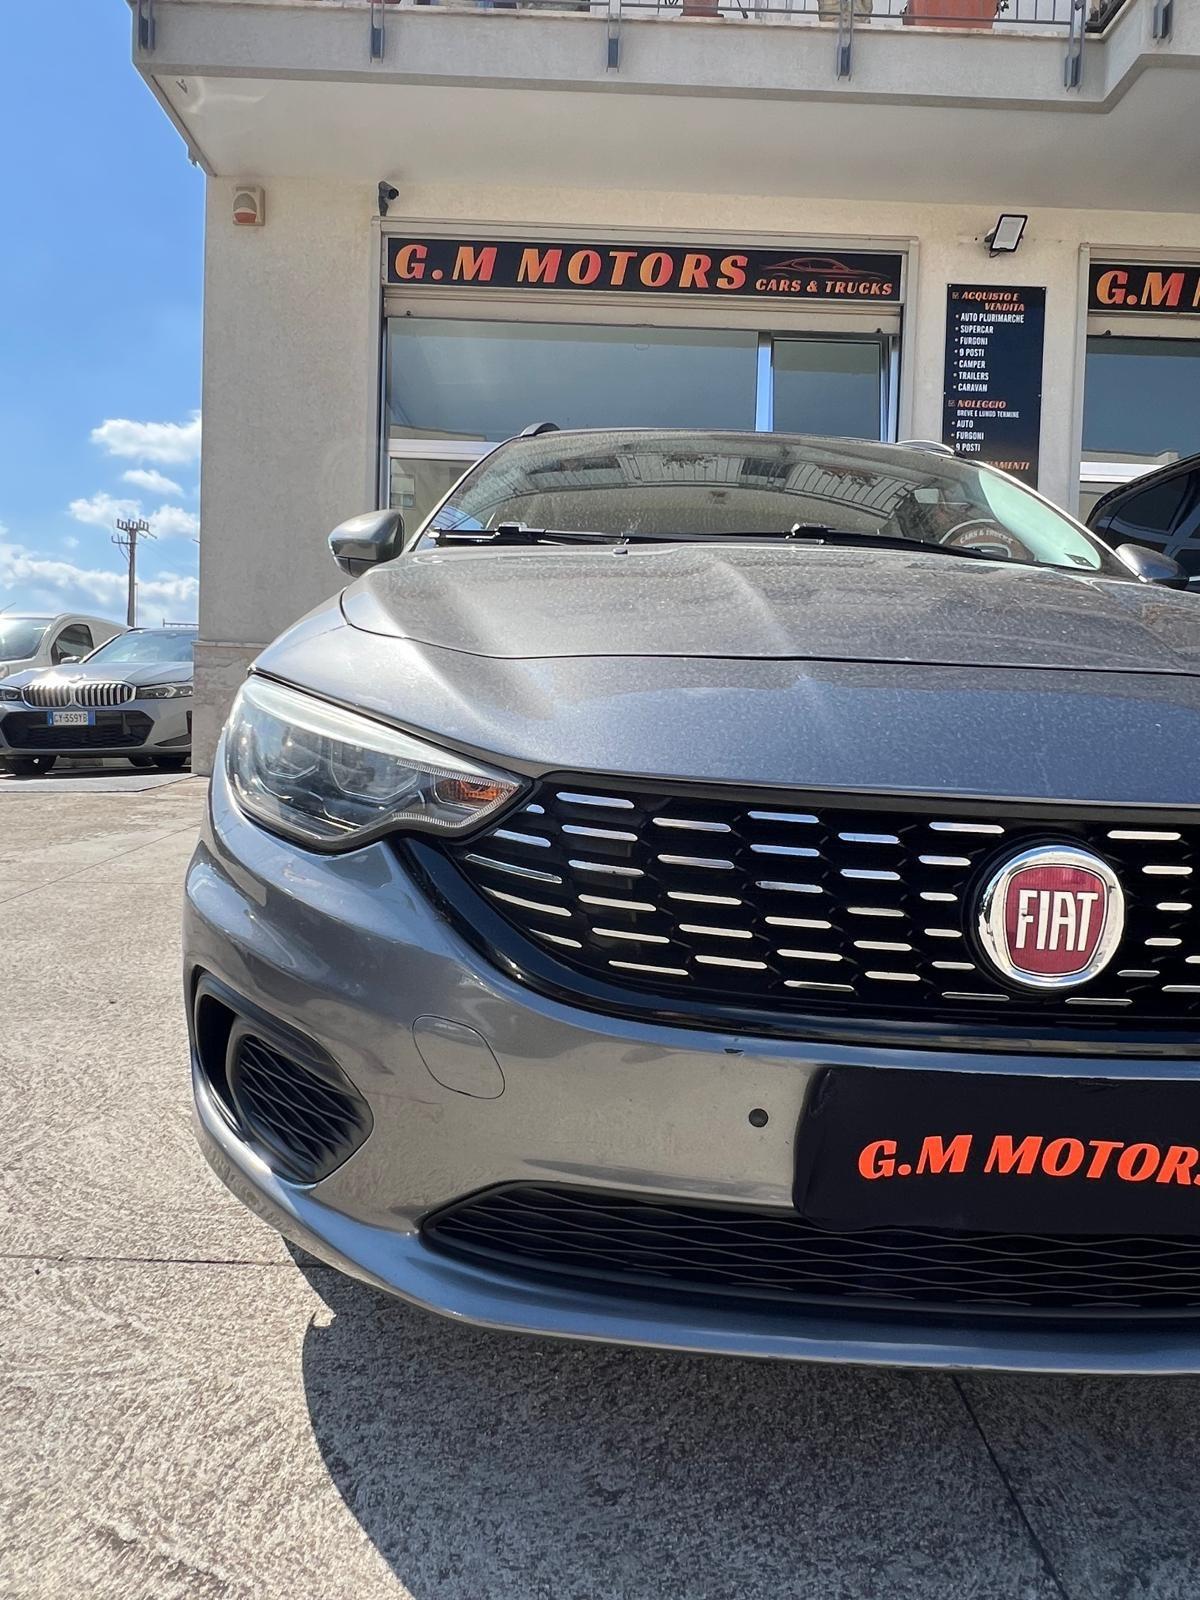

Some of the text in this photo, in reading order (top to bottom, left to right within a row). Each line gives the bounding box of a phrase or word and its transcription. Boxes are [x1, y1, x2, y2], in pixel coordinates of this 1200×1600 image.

[394, 244, 748, 289] G.M MOTORS
[755, 278, 893, 295] CARS & TRUCKS
[1096, 270, 1185, 306] G.M
[961, 291, 1020, 301] ACQUISTO E
[984, 302, 1025, 312] VENDITA
[960, 312, 1025, 324] AUTO PLURIMARCHE
[960, 325, 994, 334] SUPERCAR
[959, 336, 988, 345] FURGONI
[965, 348, 985, 357] POSTI
[958, 360, 986, 369] CAMPER
[958, 371, 989, 381] TRAILERS
[957, 383, 988, 392] CARAVAN
[957, 400, 1007, 409] NOLEGGIO
[957, 409, 974, 417] BREVE
[956, 420, 974, 428] AUTO
[956, 431, 984, 440] FURGONI
[955, 443, 981, 452] 9 POSTI
[1015, 889, 1099, 952] FIAT
[858, 1134, 1200, 1186] G.M MOTOR
